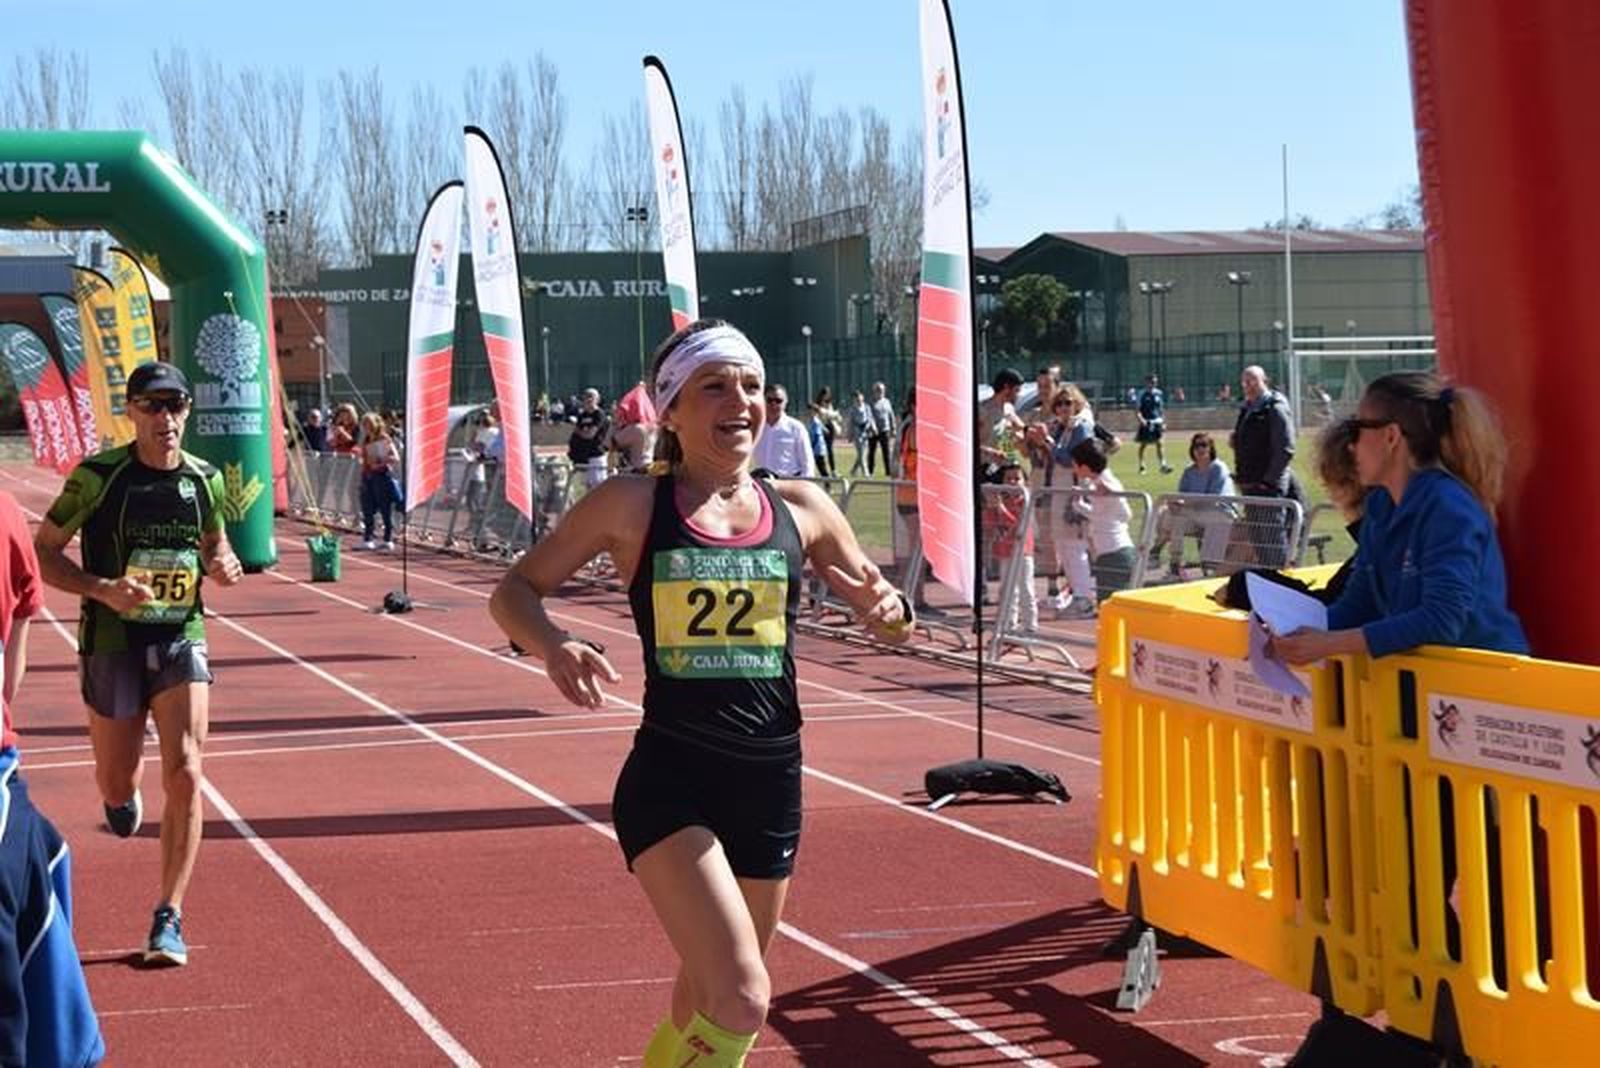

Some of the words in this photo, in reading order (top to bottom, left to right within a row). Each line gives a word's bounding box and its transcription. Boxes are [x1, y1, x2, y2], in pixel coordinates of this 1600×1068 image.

[0, 162, 111, 192] URAL
[370, 289, 389, 302] DE
[392, 289, 410, 302] ZA
[547, 279, 604, 298] CAJA
[612, 280, 668, 297] RUR
[687, 587, 755, 637] 22
[692, 655, 730, 669] CAJA
[732, 655, 775, 669] RURAL
